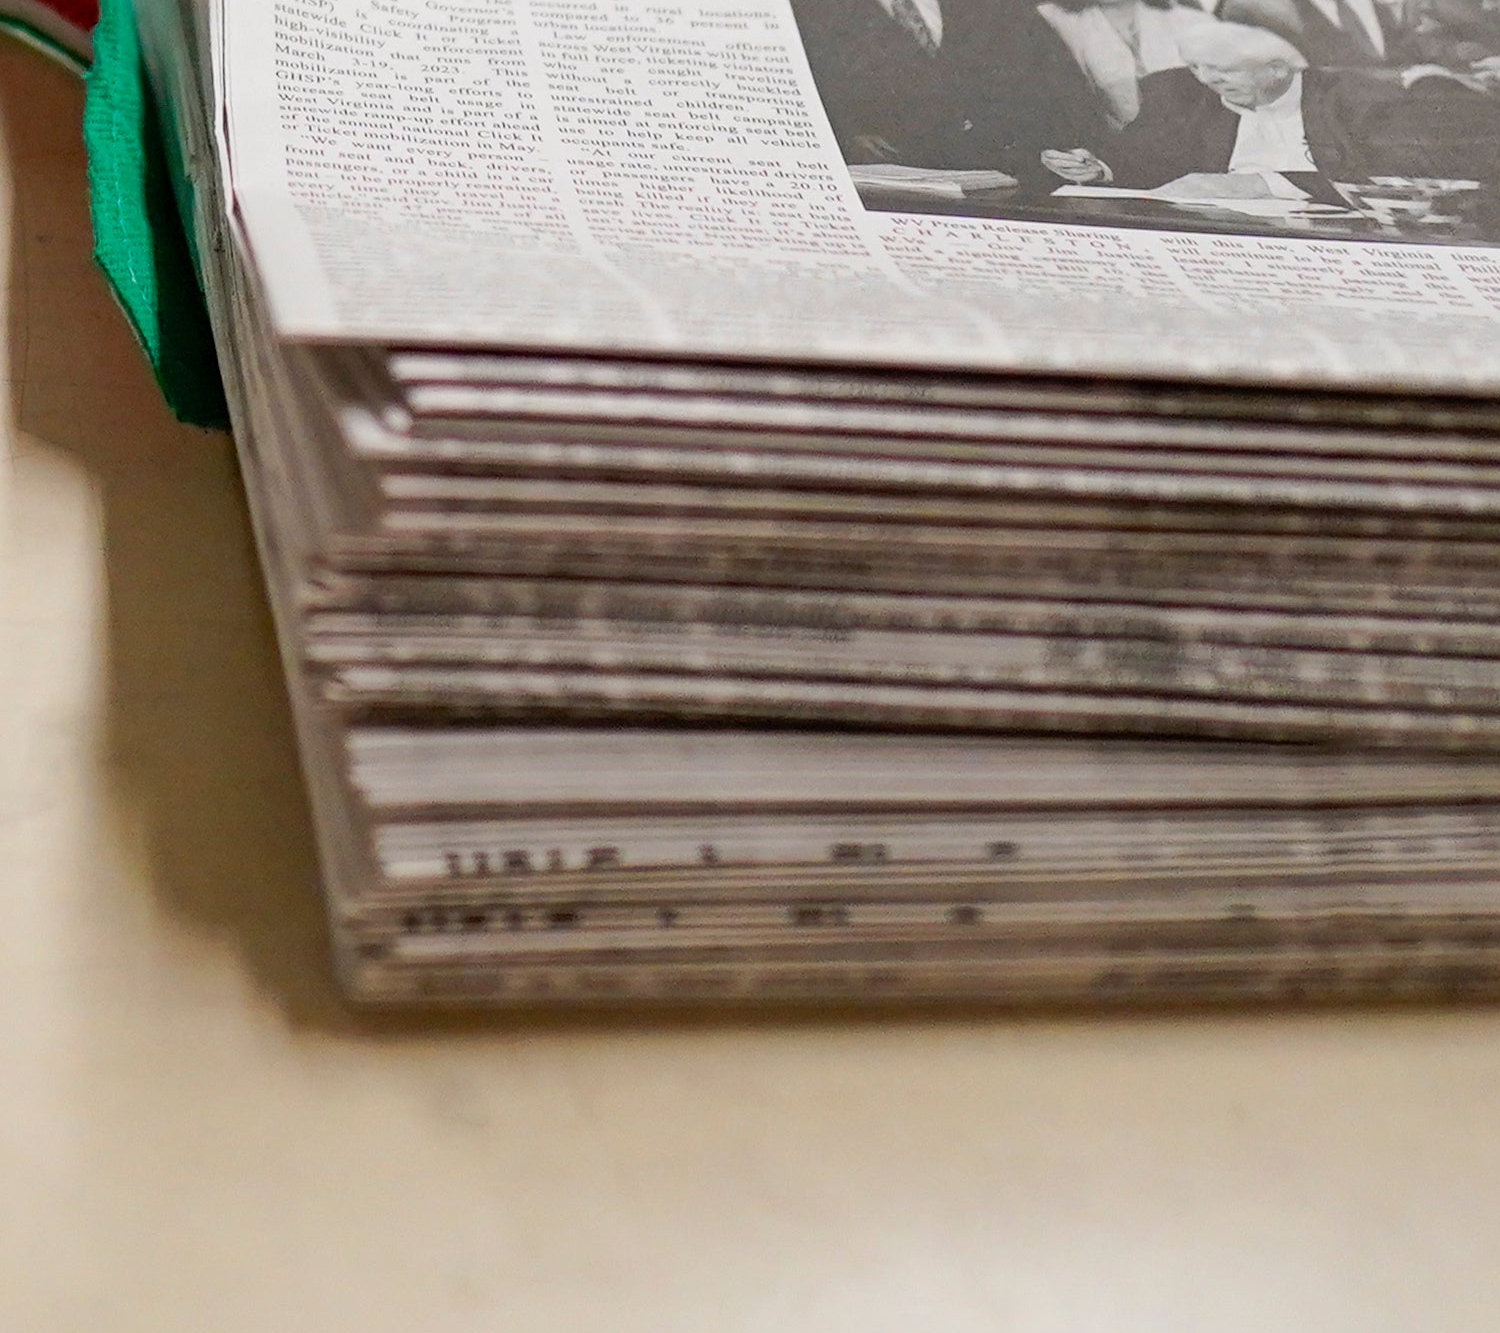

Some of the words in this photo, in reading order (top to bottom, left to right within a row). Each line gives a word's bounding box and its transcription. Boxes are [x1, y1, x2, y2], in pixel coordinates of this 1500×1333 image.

[277, 83, 344, 96] increase
[360, 91, 392, 100] seat
[409, 94, 440, 103] belt
[457, 99, 503, 109] usage
[520, 102, 536, 110] in
[277, 93, 318, 104] West
[327, 98, 395, 112] Virginia
[402, 105, 432, 114] and
[442, 107, 454, 115] is
[463, 109, 495, 118] part
[504, 112, 522, 120] of
[279, 104, 358, 117] statewide
[363, 111, 434, 126] ramp-up
[440, 117, 487, 129] effort
[493, 123, 540, 132] ahead
[280, 112, 299, 121] of
[305, 115, 331, 124] the
[338, 120, 394, 131] annual
[402, 124, 470, 138] national
[477, 129, 523, 141] Click
[530, 133, 543, 143] It
[281, 122, 300, 131] or
[306, 124, 357, 137] Ticket
[364, 131, 471, 150] mobilization
[477, 141, 493, 150] in
